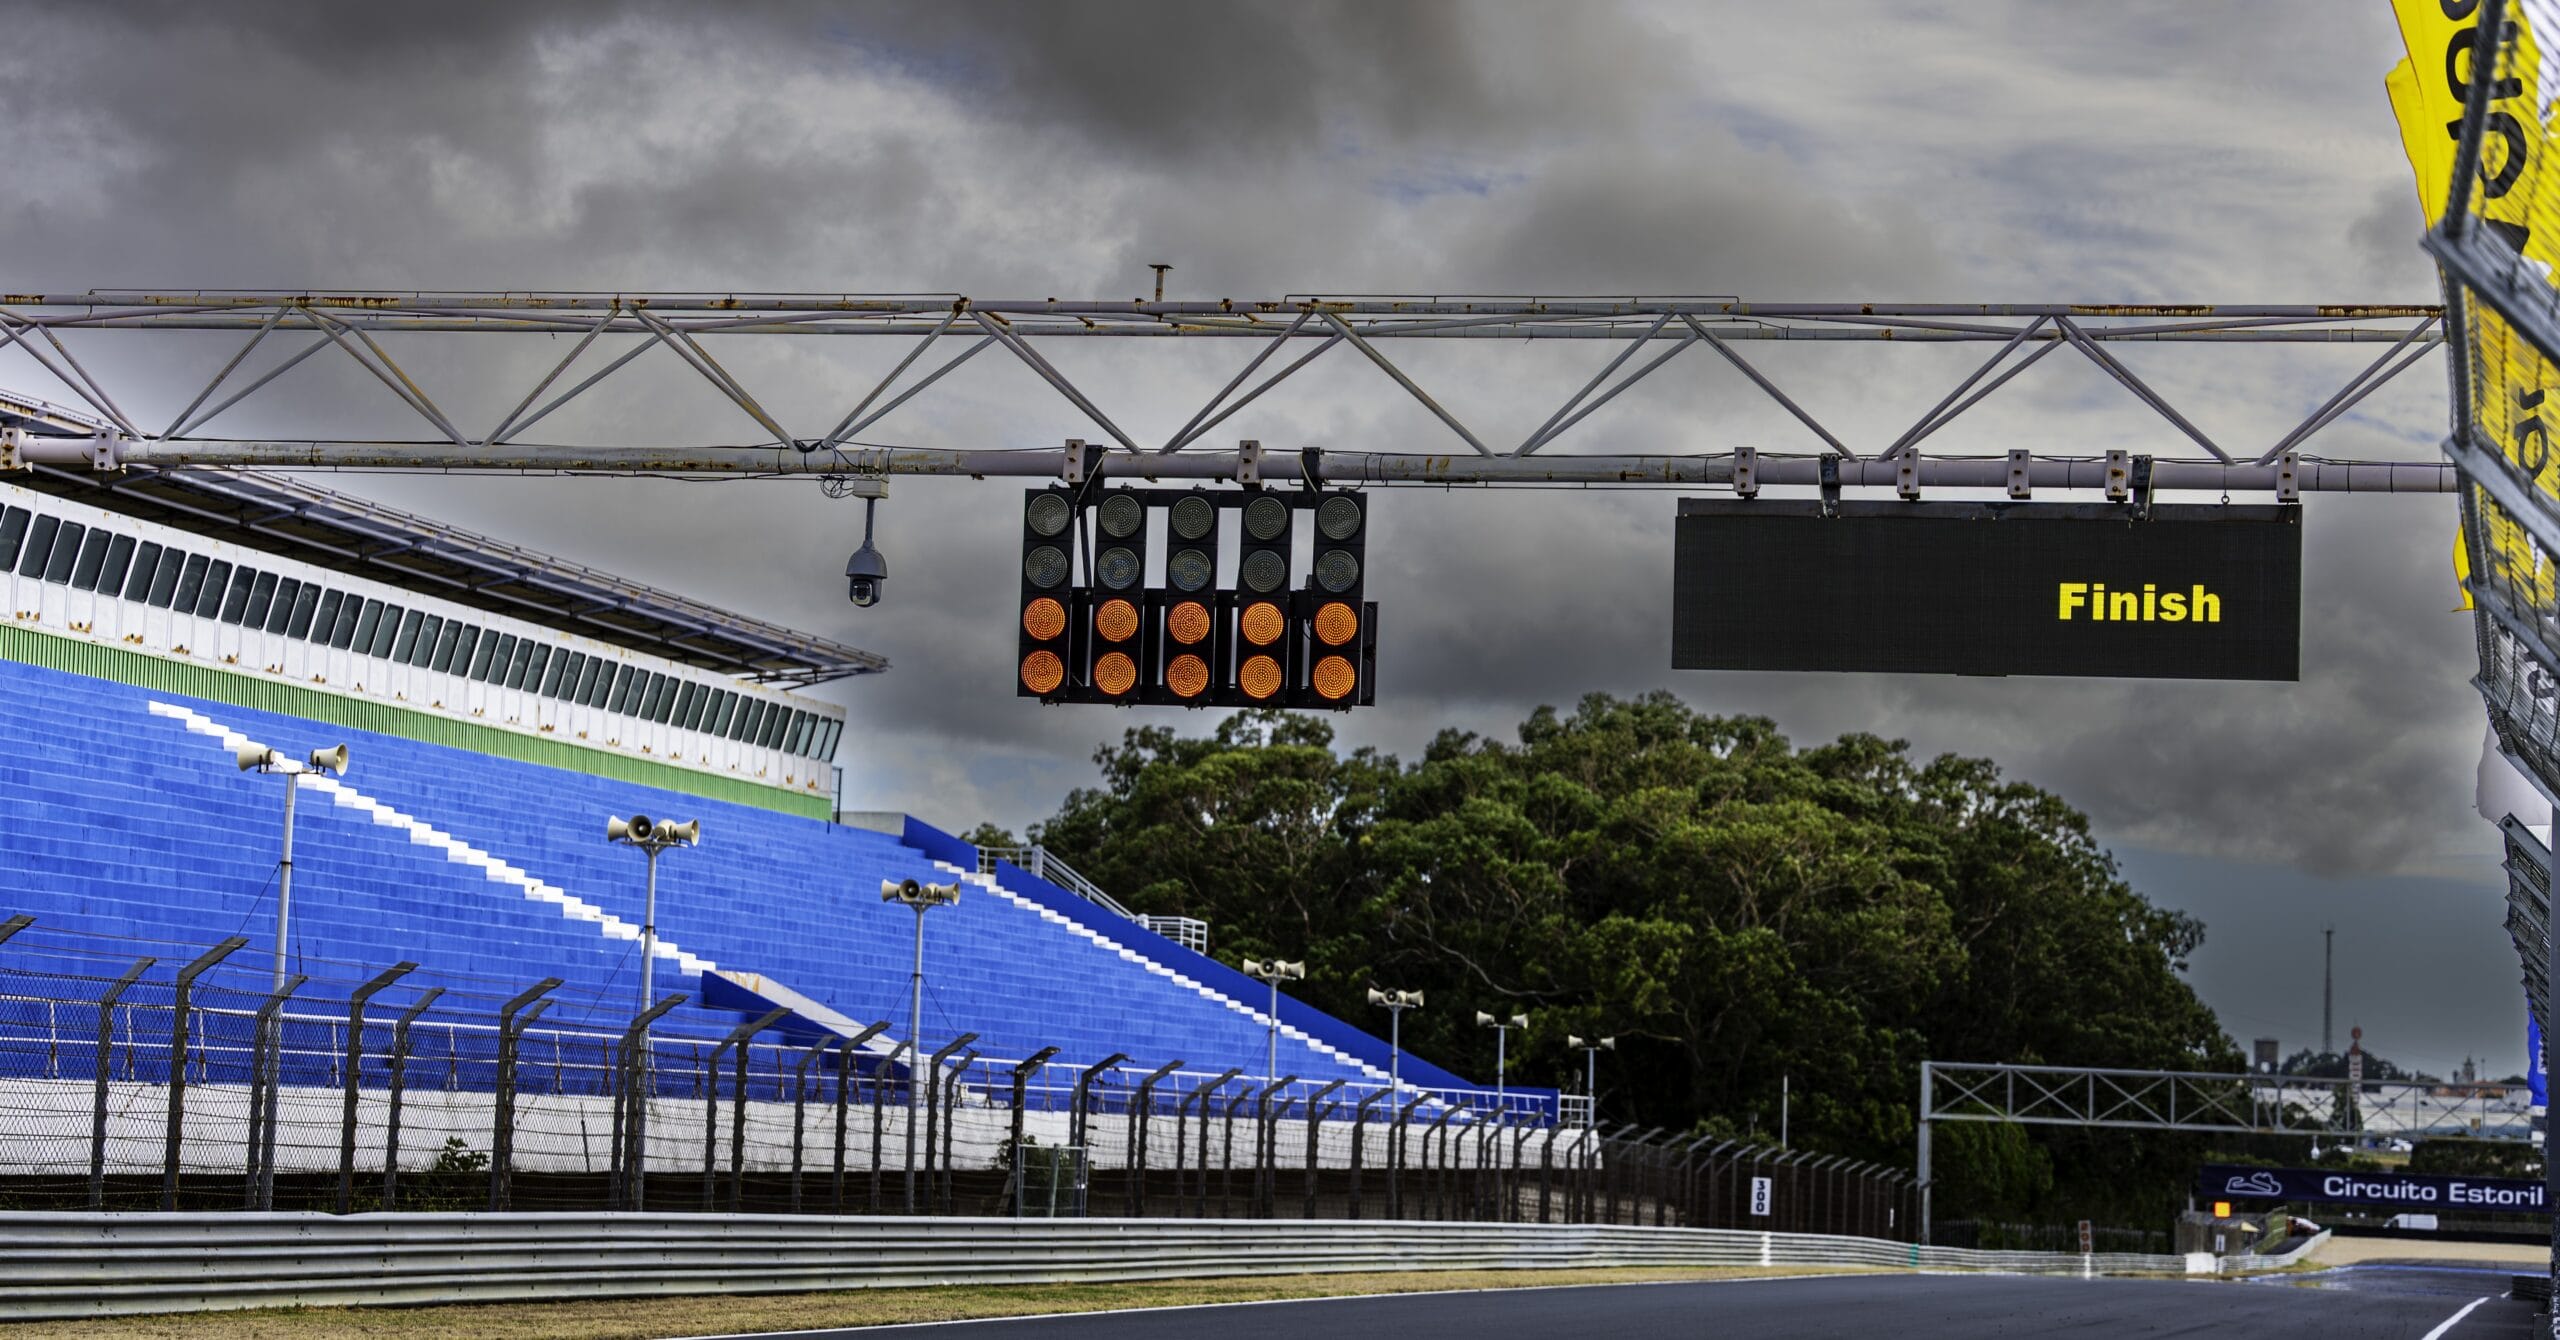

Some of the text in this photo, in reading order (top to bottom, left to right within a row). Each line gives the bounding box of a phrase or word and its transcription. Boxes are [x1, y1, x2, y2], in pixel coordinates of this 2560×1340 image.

[2059, 583, 2221, 623] Finish
[1756, 1180, 1766, 1212] 300
[2324, 1176, 2544, 1206] Circuito Estoril
